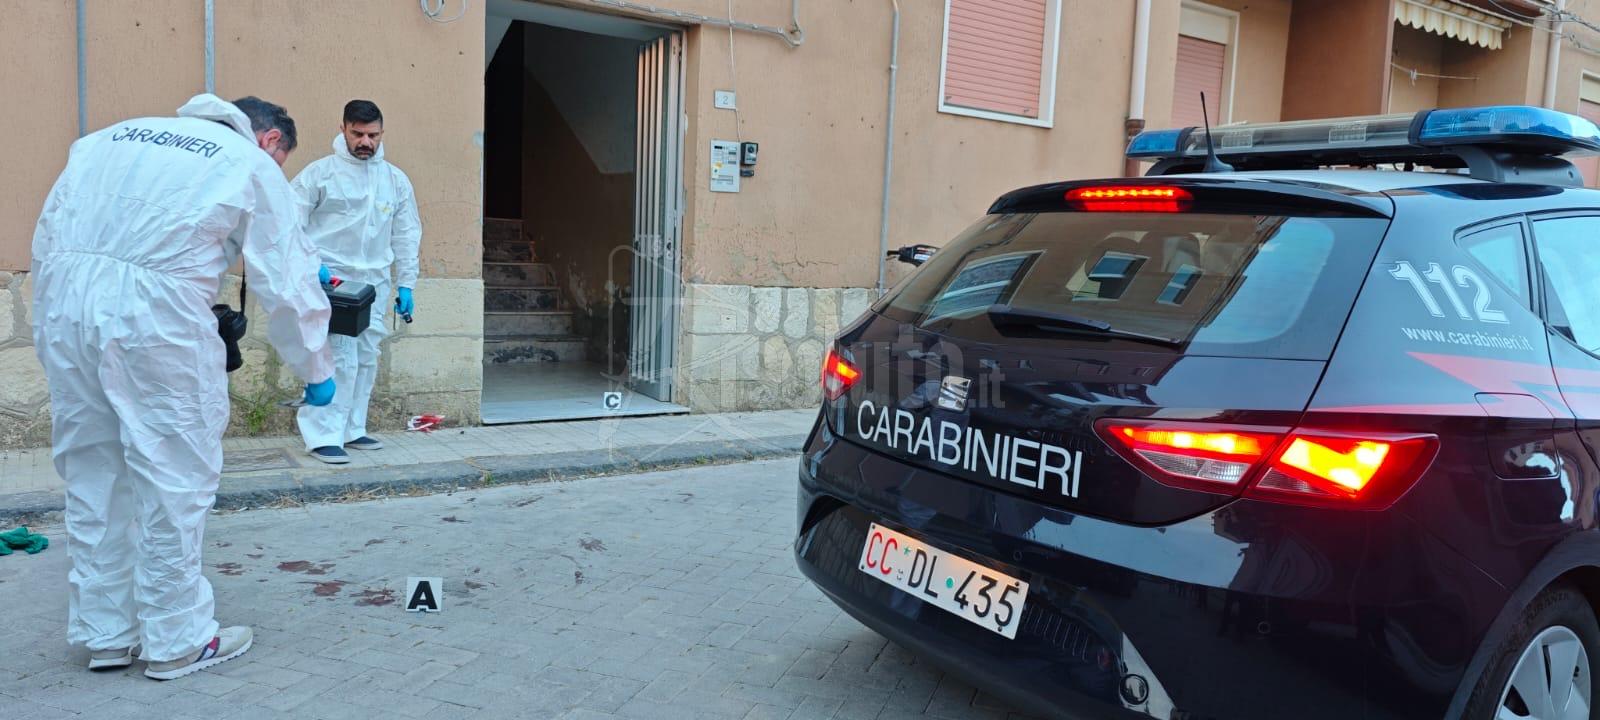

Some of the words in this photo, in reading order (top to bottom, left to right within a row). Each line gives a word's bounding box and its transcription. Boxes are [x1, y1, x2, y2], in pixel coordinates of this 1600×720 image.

[723, 96, 729, 105] 2
[112, 127, 223, 158] CARABINIERI
[1388, 260, 1510, 324] 112
[1401, 327, 1534, 351] www.carabinieri.it
[605, 394, 620, 408] C
[857, 400, 1083, 498] CARABINIERI
[866, 532, 898, 575] CC
[908, 549, 938, 599] DL
[953, 570, 1020, 627] 435
[407, 580, 438, 610] A
